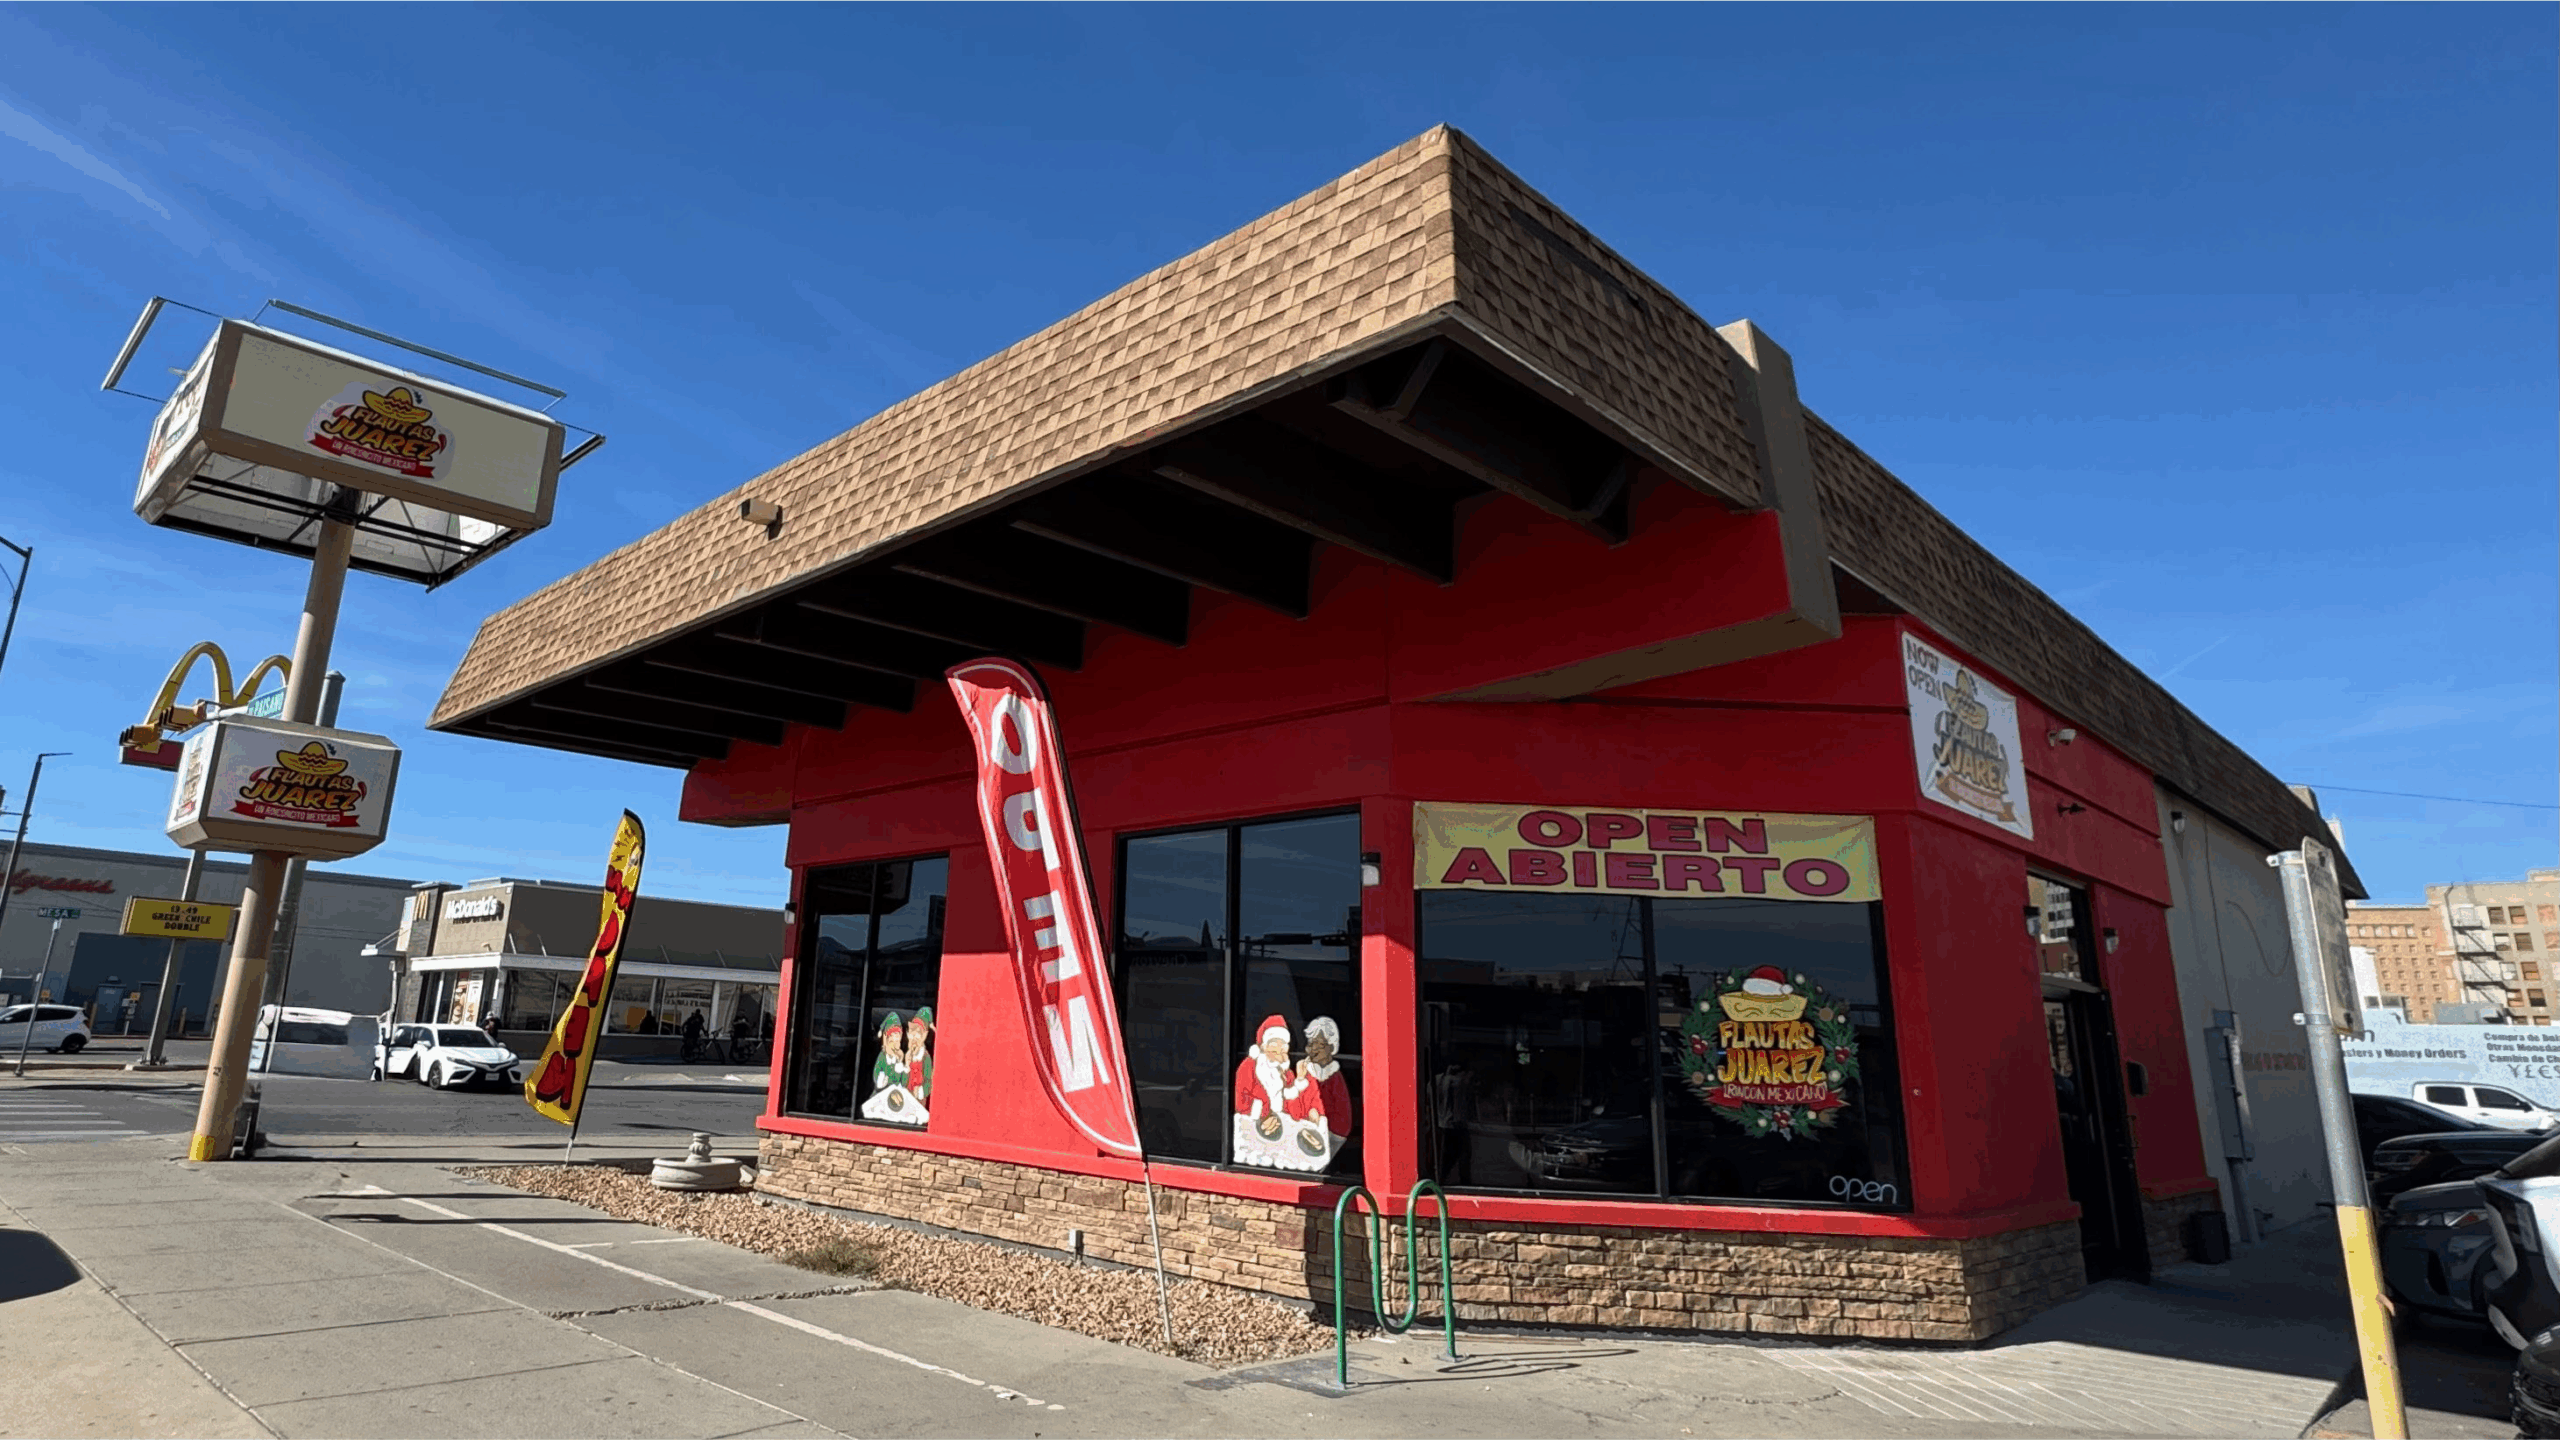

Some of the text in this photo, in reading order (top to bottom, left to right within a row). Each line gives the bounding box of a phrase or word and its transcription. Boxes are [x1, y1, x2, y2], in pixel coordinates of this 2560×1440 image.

[320, 415, 440, 462] JUAREZ
[351, 407, 436, 441] FLAUTAS
[1905, 638, 1940, 676] NOW
[1908, 664, 1943, 702] OPEN
[240, 778, 362, 812] JUAREZ
[268, 766, 355, 791] FLAUTAS
[1517, 809, 1769, 854] OPEN
[1441, 846, 1850, 896] ABIERTO
[39, 908, 69, 918] MESA
[445, 895, 498, 920] McDonald's
[1718, 1020, 1815, 1050] FLAUTAS
[1717, 1046, 1828, 1085] JUAREZ
[2384, 1048, 2423, 1059] Money
[2425, 1048, 2467, 1059] Orders
[1829, 1175, 1897, 1204] open
